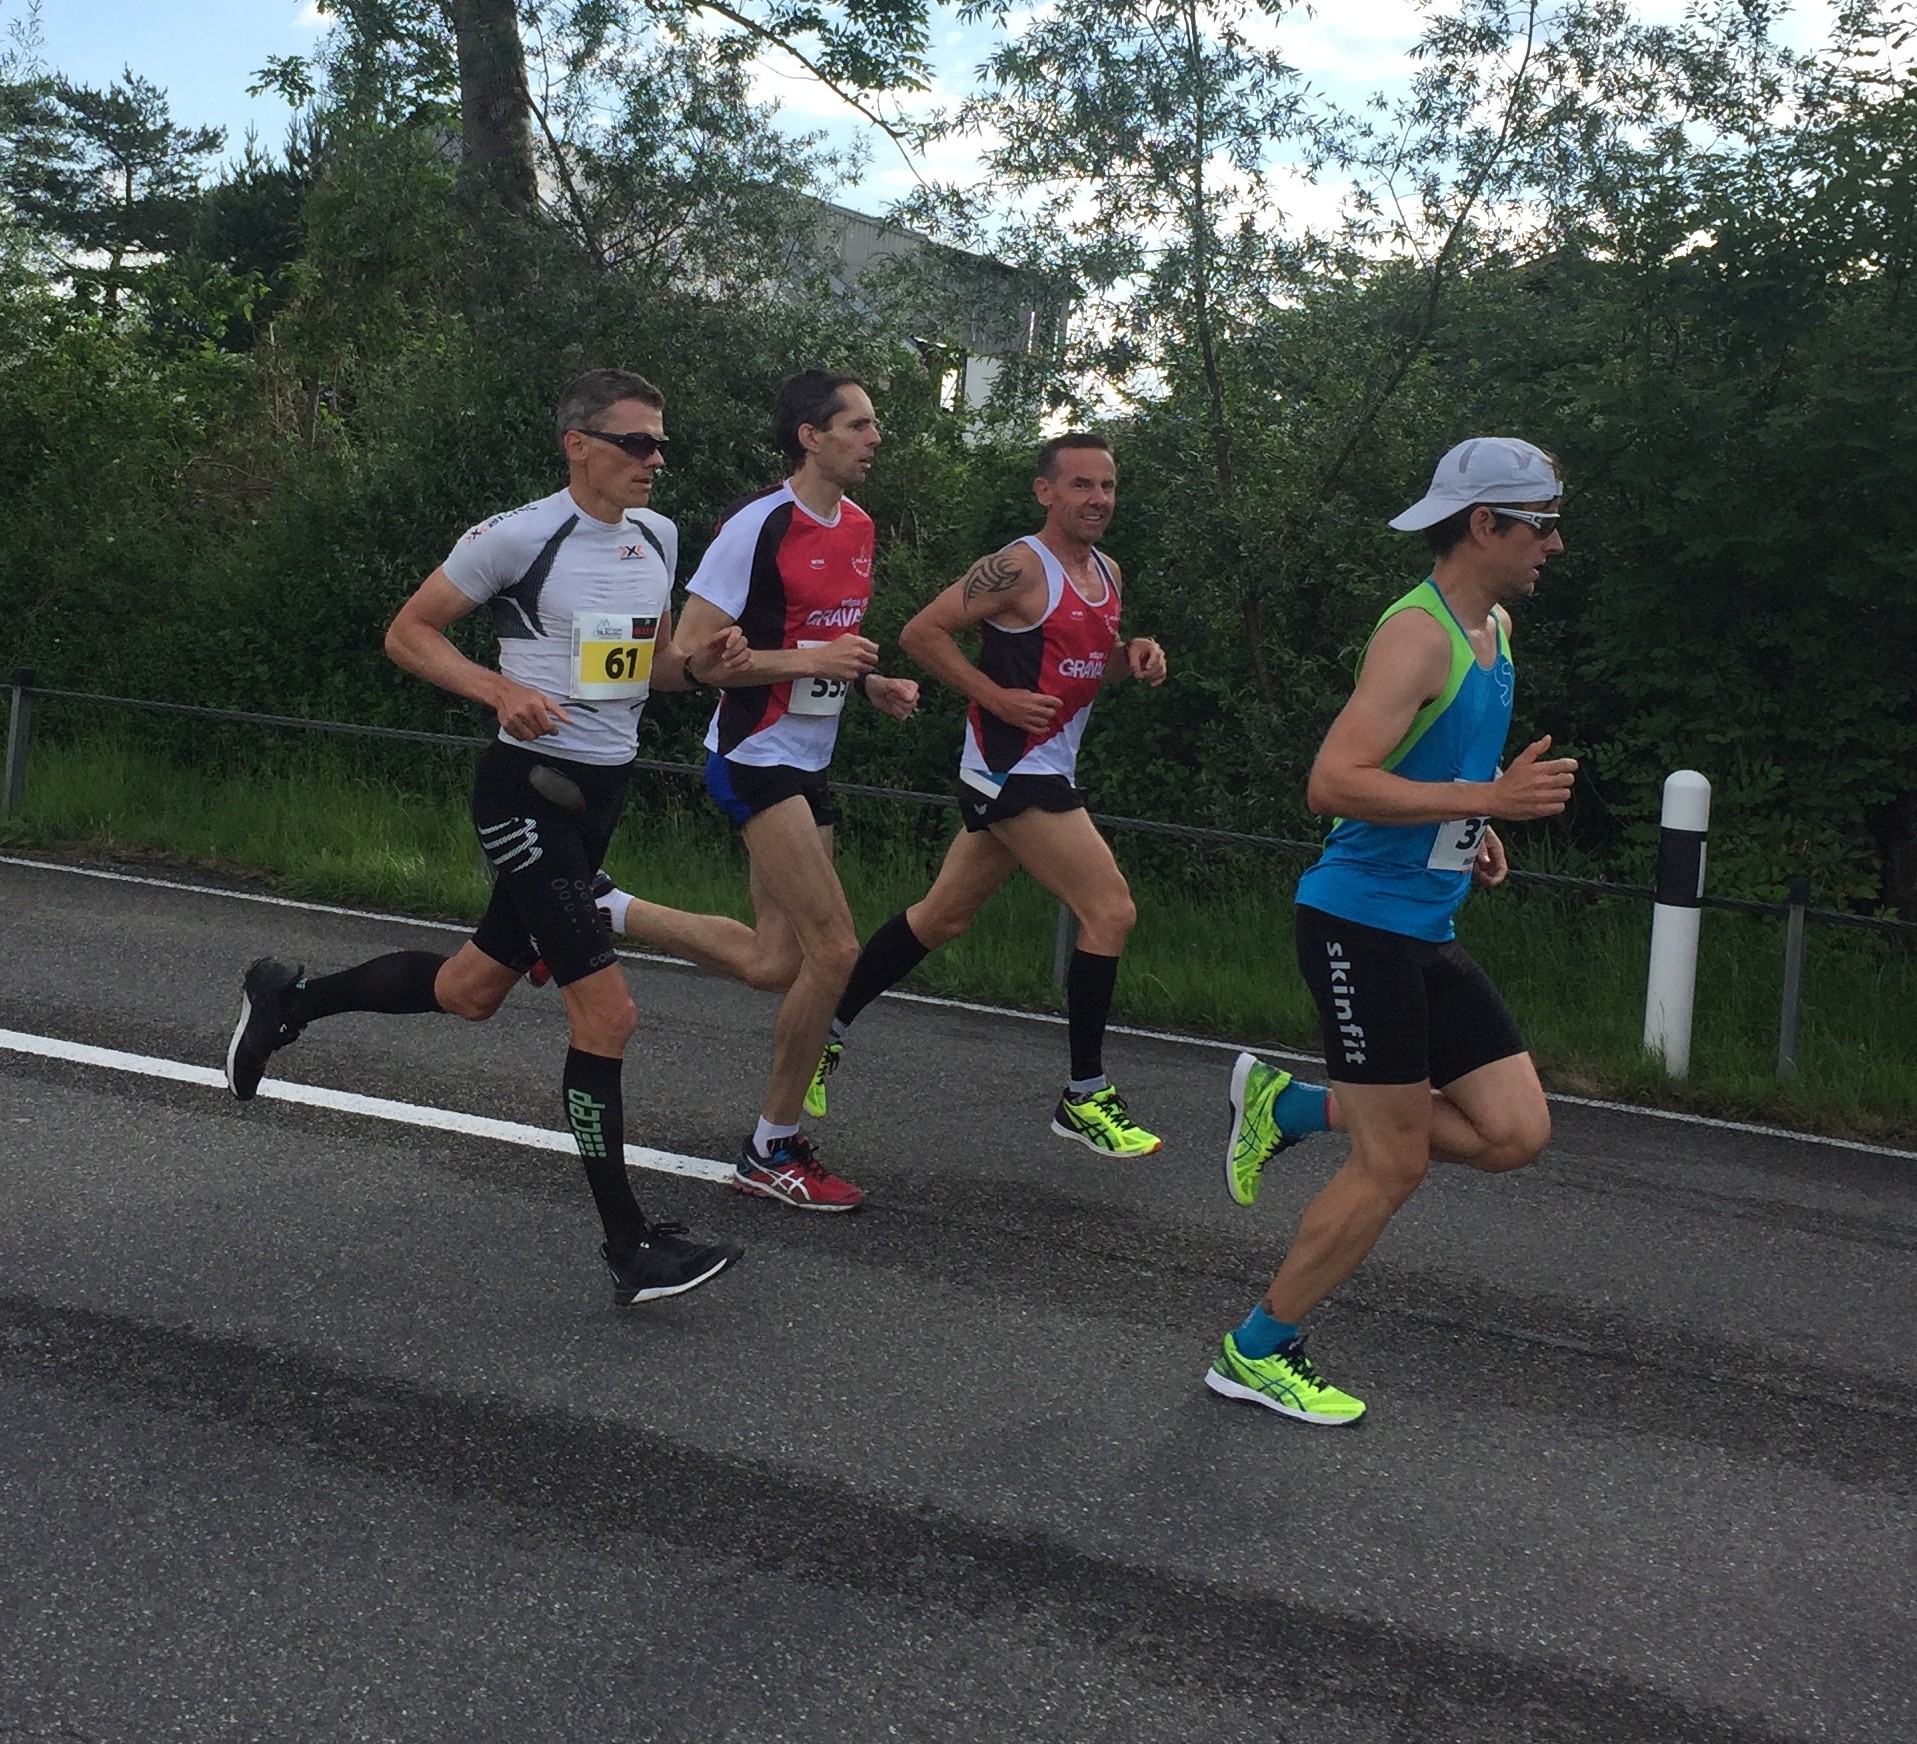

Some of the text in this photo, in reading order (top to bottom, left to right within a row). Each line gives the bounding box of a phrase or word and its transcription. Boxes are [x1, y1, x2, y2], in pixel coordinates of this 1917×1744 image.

[605, 647, 638, 679] 61
[1326, 941, 1367, 1065] skinfit
[568, 1088, 606, 1135] cep
